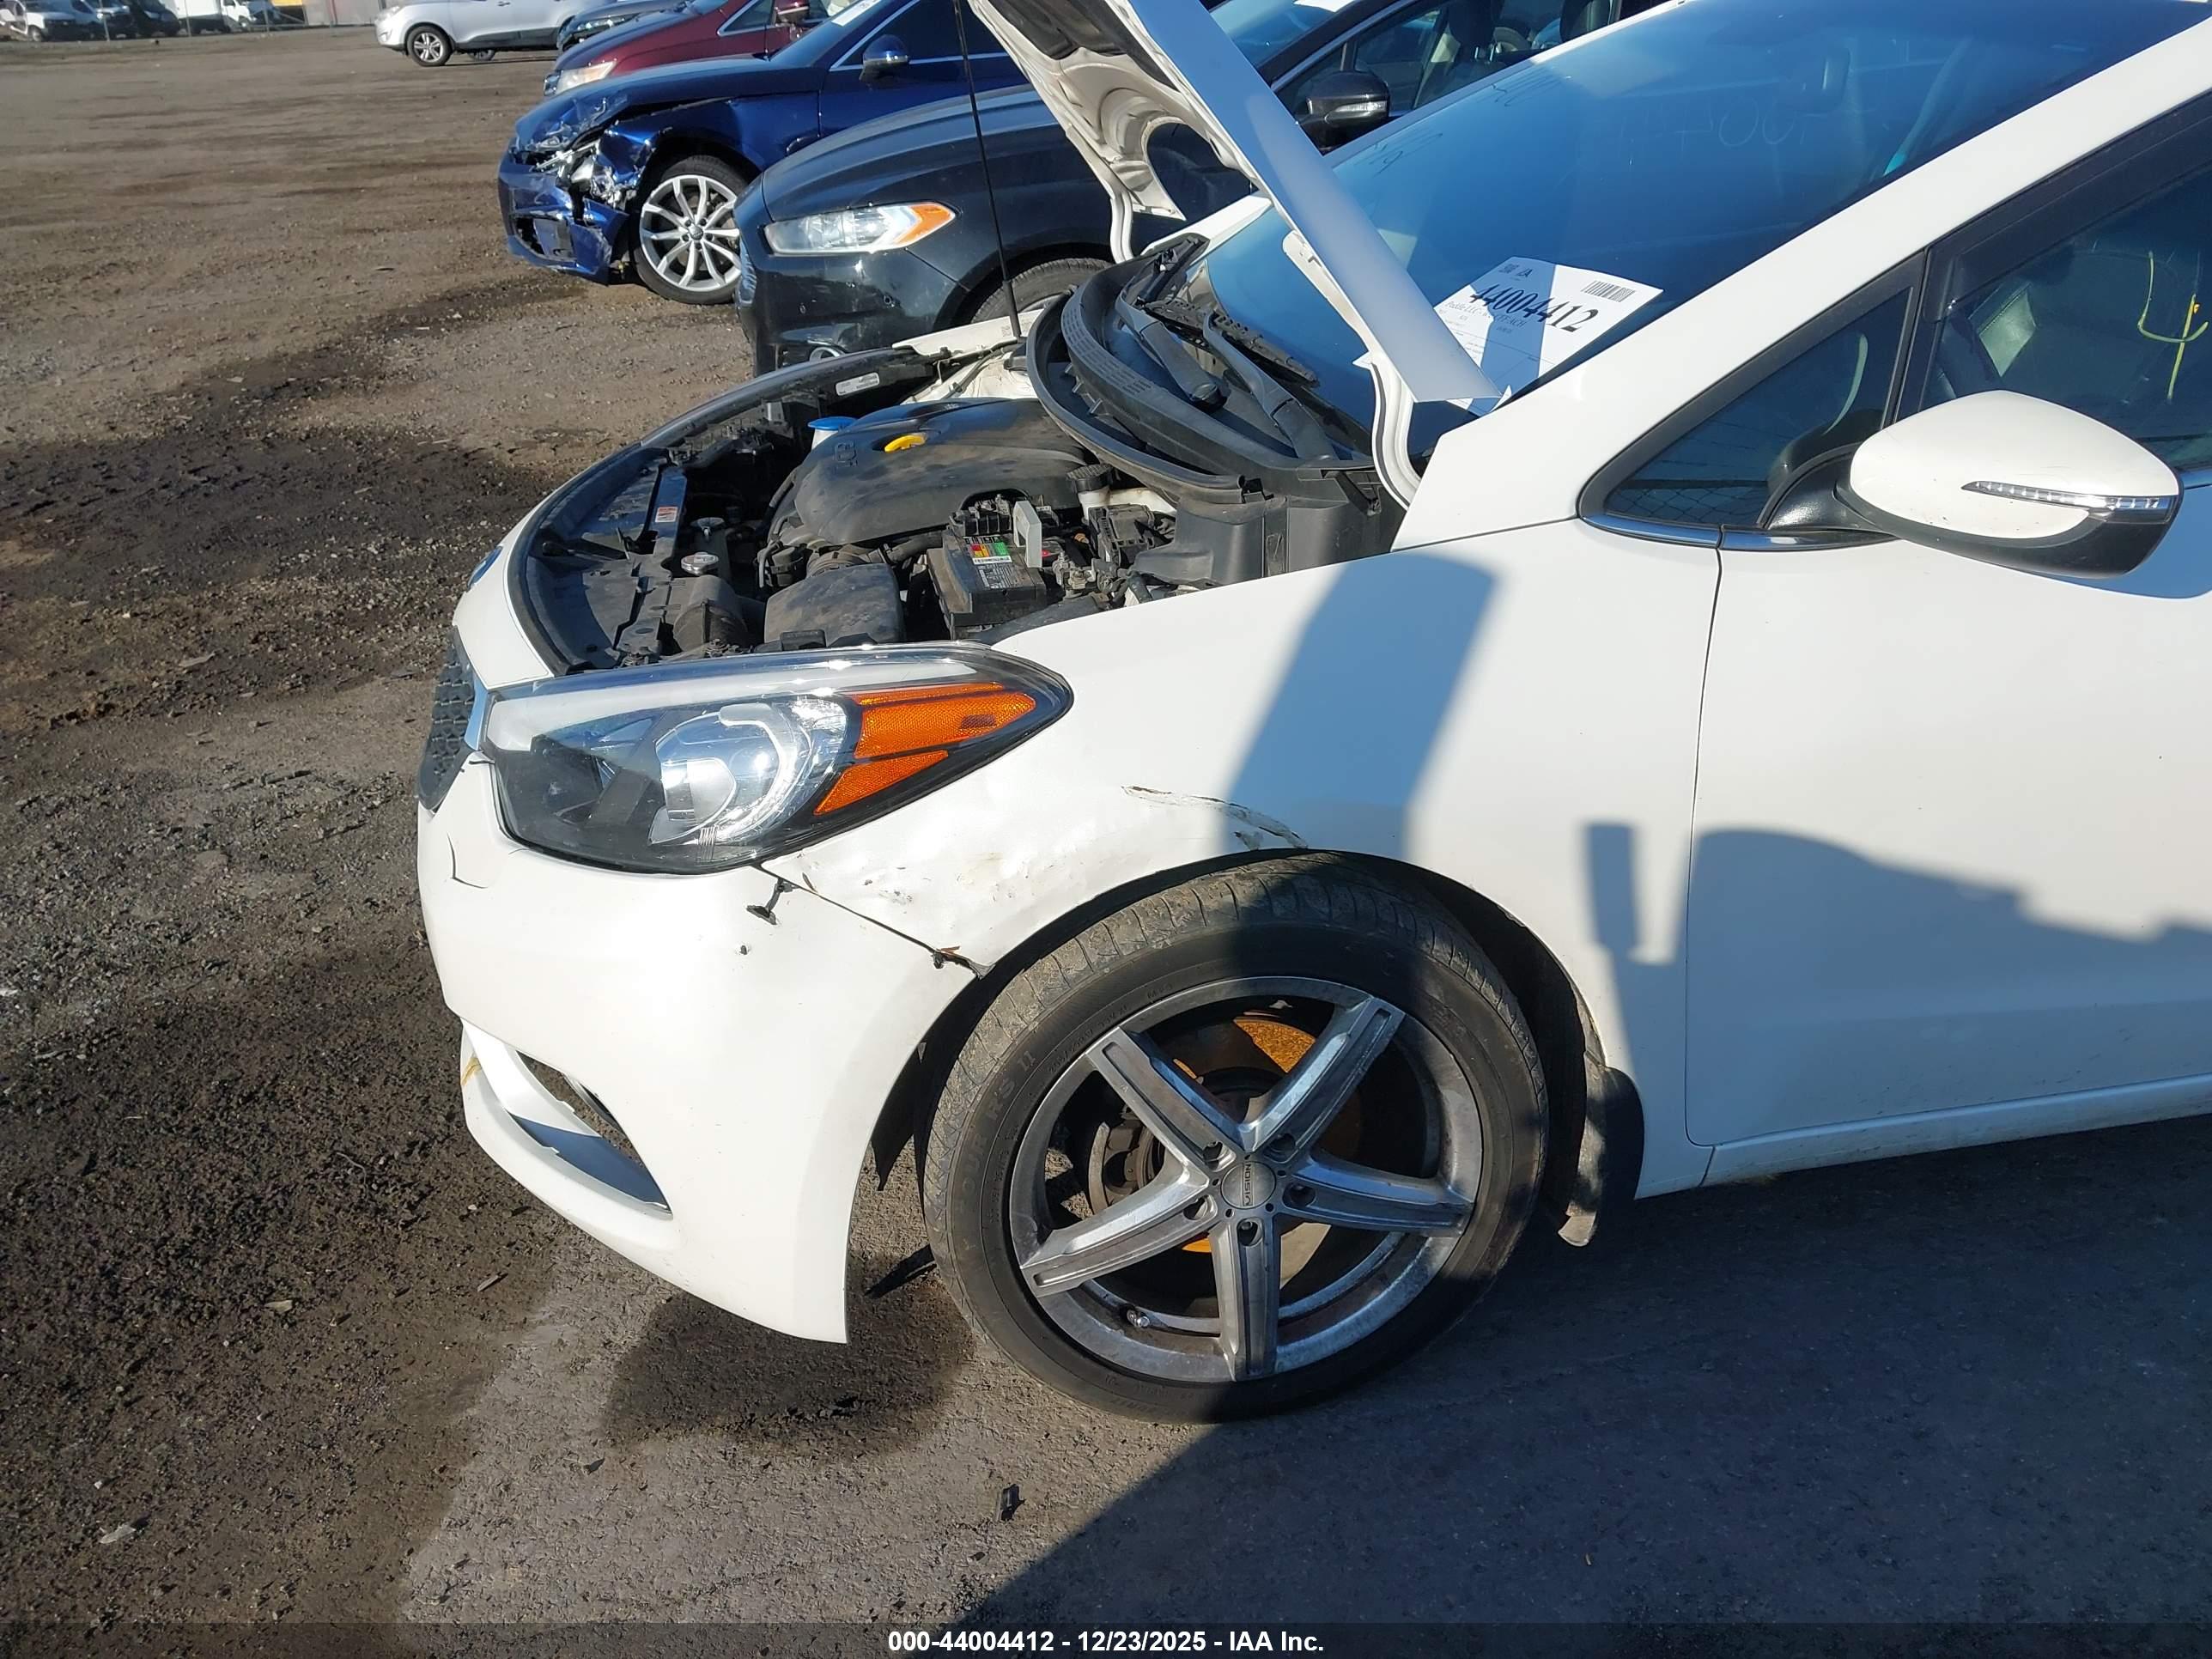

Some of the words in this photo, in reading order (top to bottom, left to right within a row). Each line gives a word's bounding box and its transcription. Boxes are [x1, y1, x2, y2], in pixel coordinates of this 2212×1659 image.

[1469, 284, 1598, 333] 44004412
[2136, 251, 2209, 402] 4
[1243, 1162, 1253, 1206] VISION
